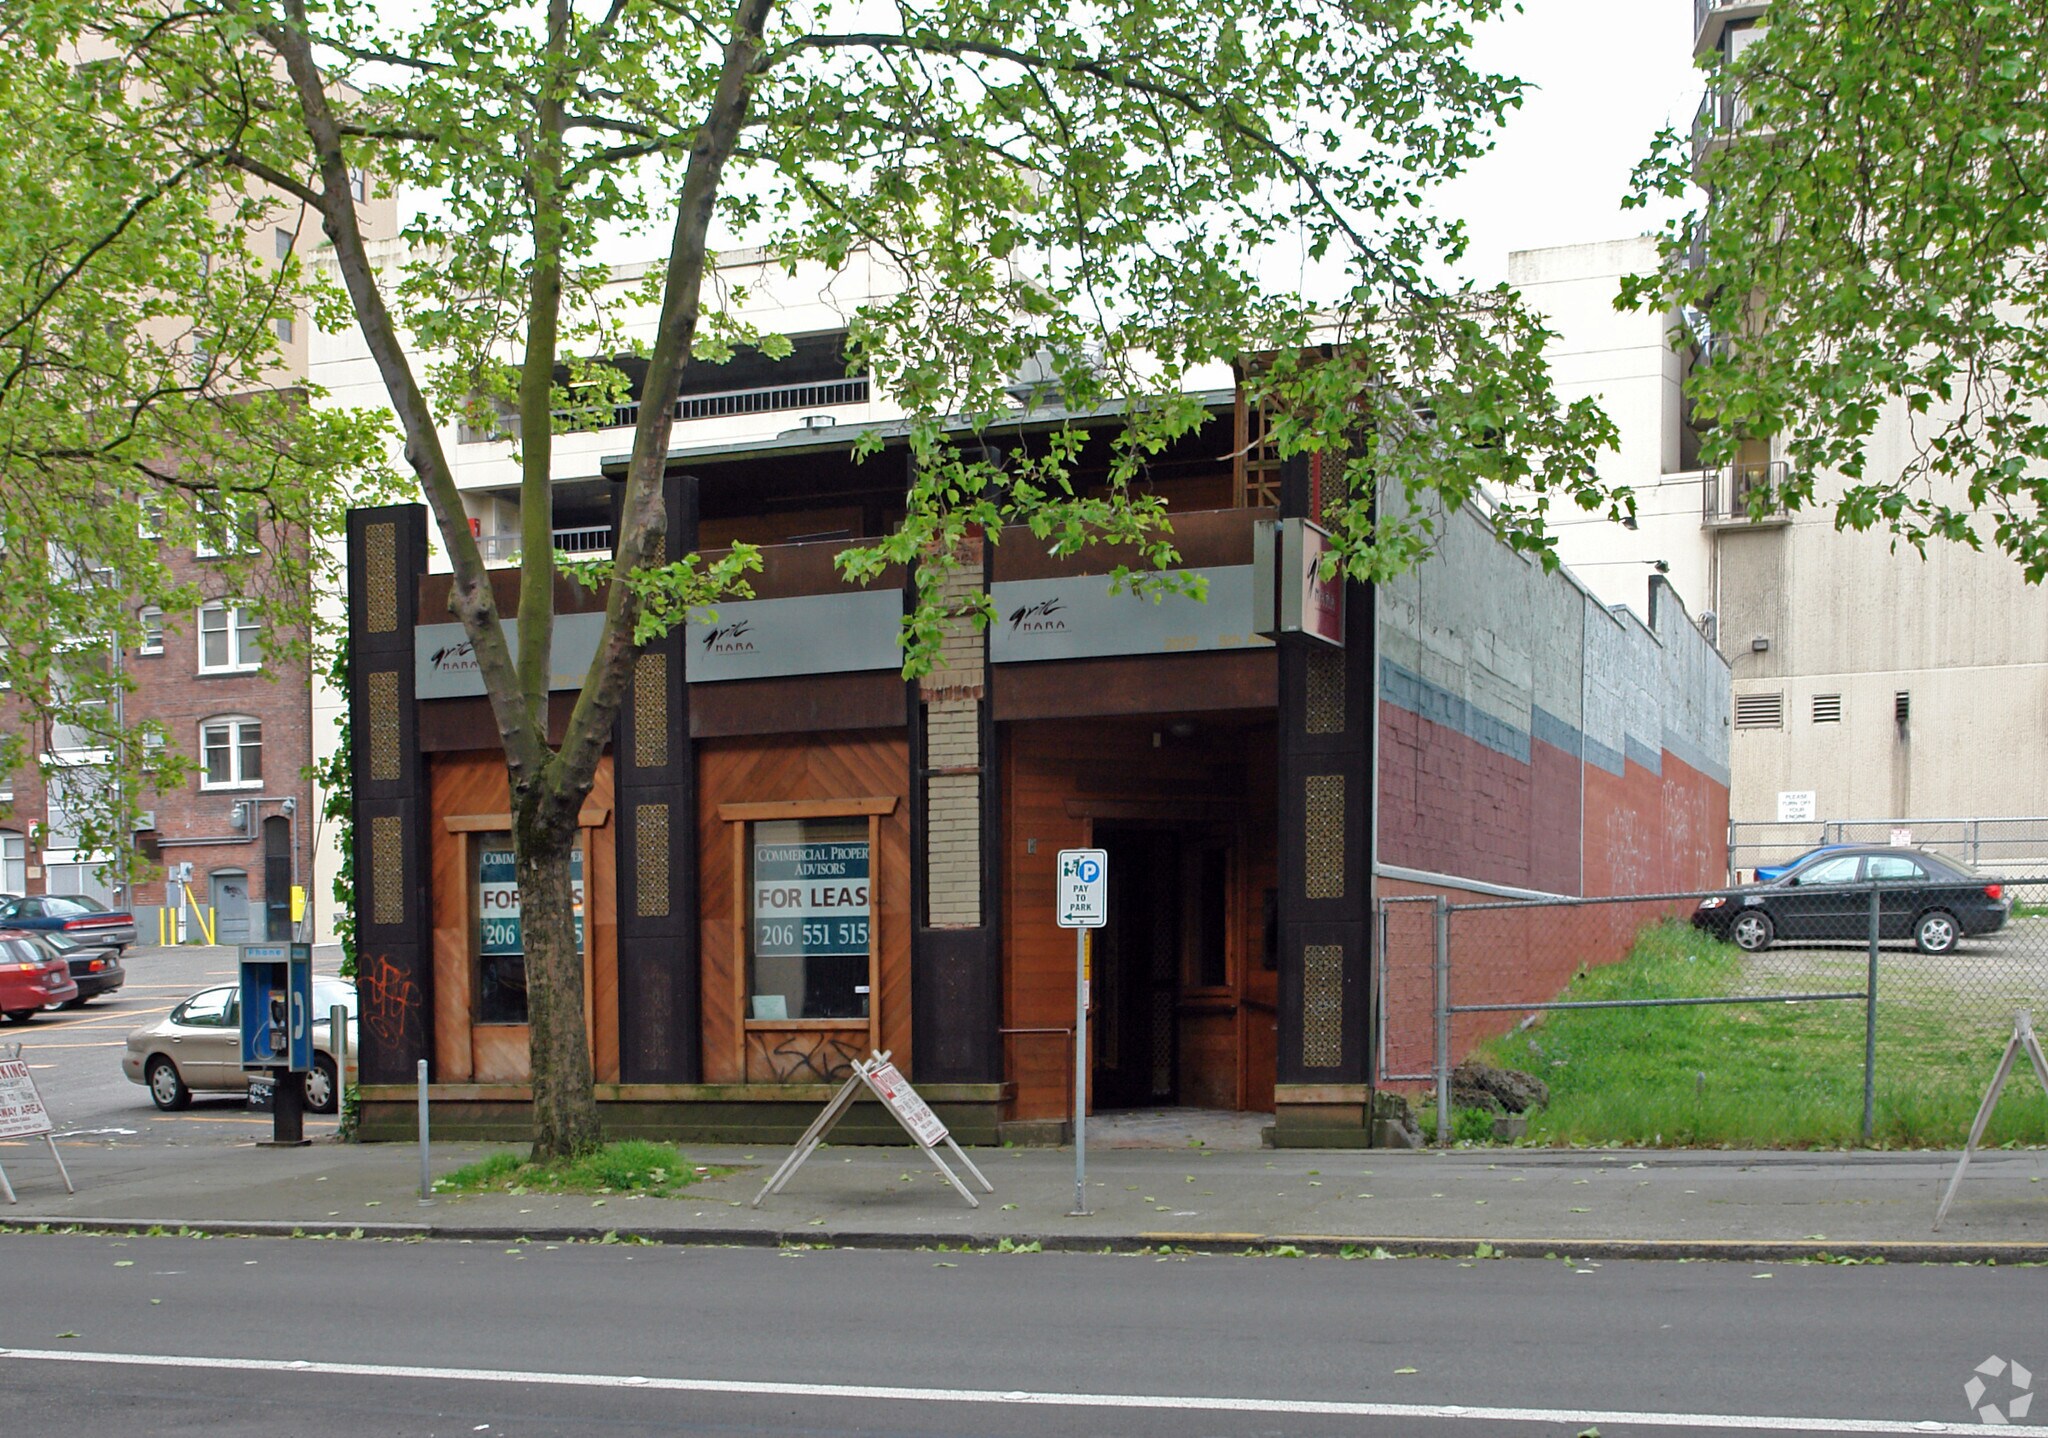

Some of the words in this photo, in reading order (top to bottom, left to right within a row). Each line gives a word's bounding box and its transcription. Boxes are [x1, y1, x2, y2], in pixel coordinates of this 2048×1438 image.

[758, 848, 828, 862] COMMERCIAL
[830, 846, 869, 860] PROPER
[794, 862, 846, 876] ADVISORS
[758, 888, 802, 908] FOR
[811, 886, 870, 907] LEAS
[1076, 894, 1086, 902] TO
[486, 924, 516, 945] 206
[761, 924, 793, 946] 206
[802, 923, 830, 945] 551
[839, 922, 870, 944] 515
[248, 947, 282, 957] Phone
[0, 1063, 27, 1079] KING
[20, 1103, 44, 1115] AREA
